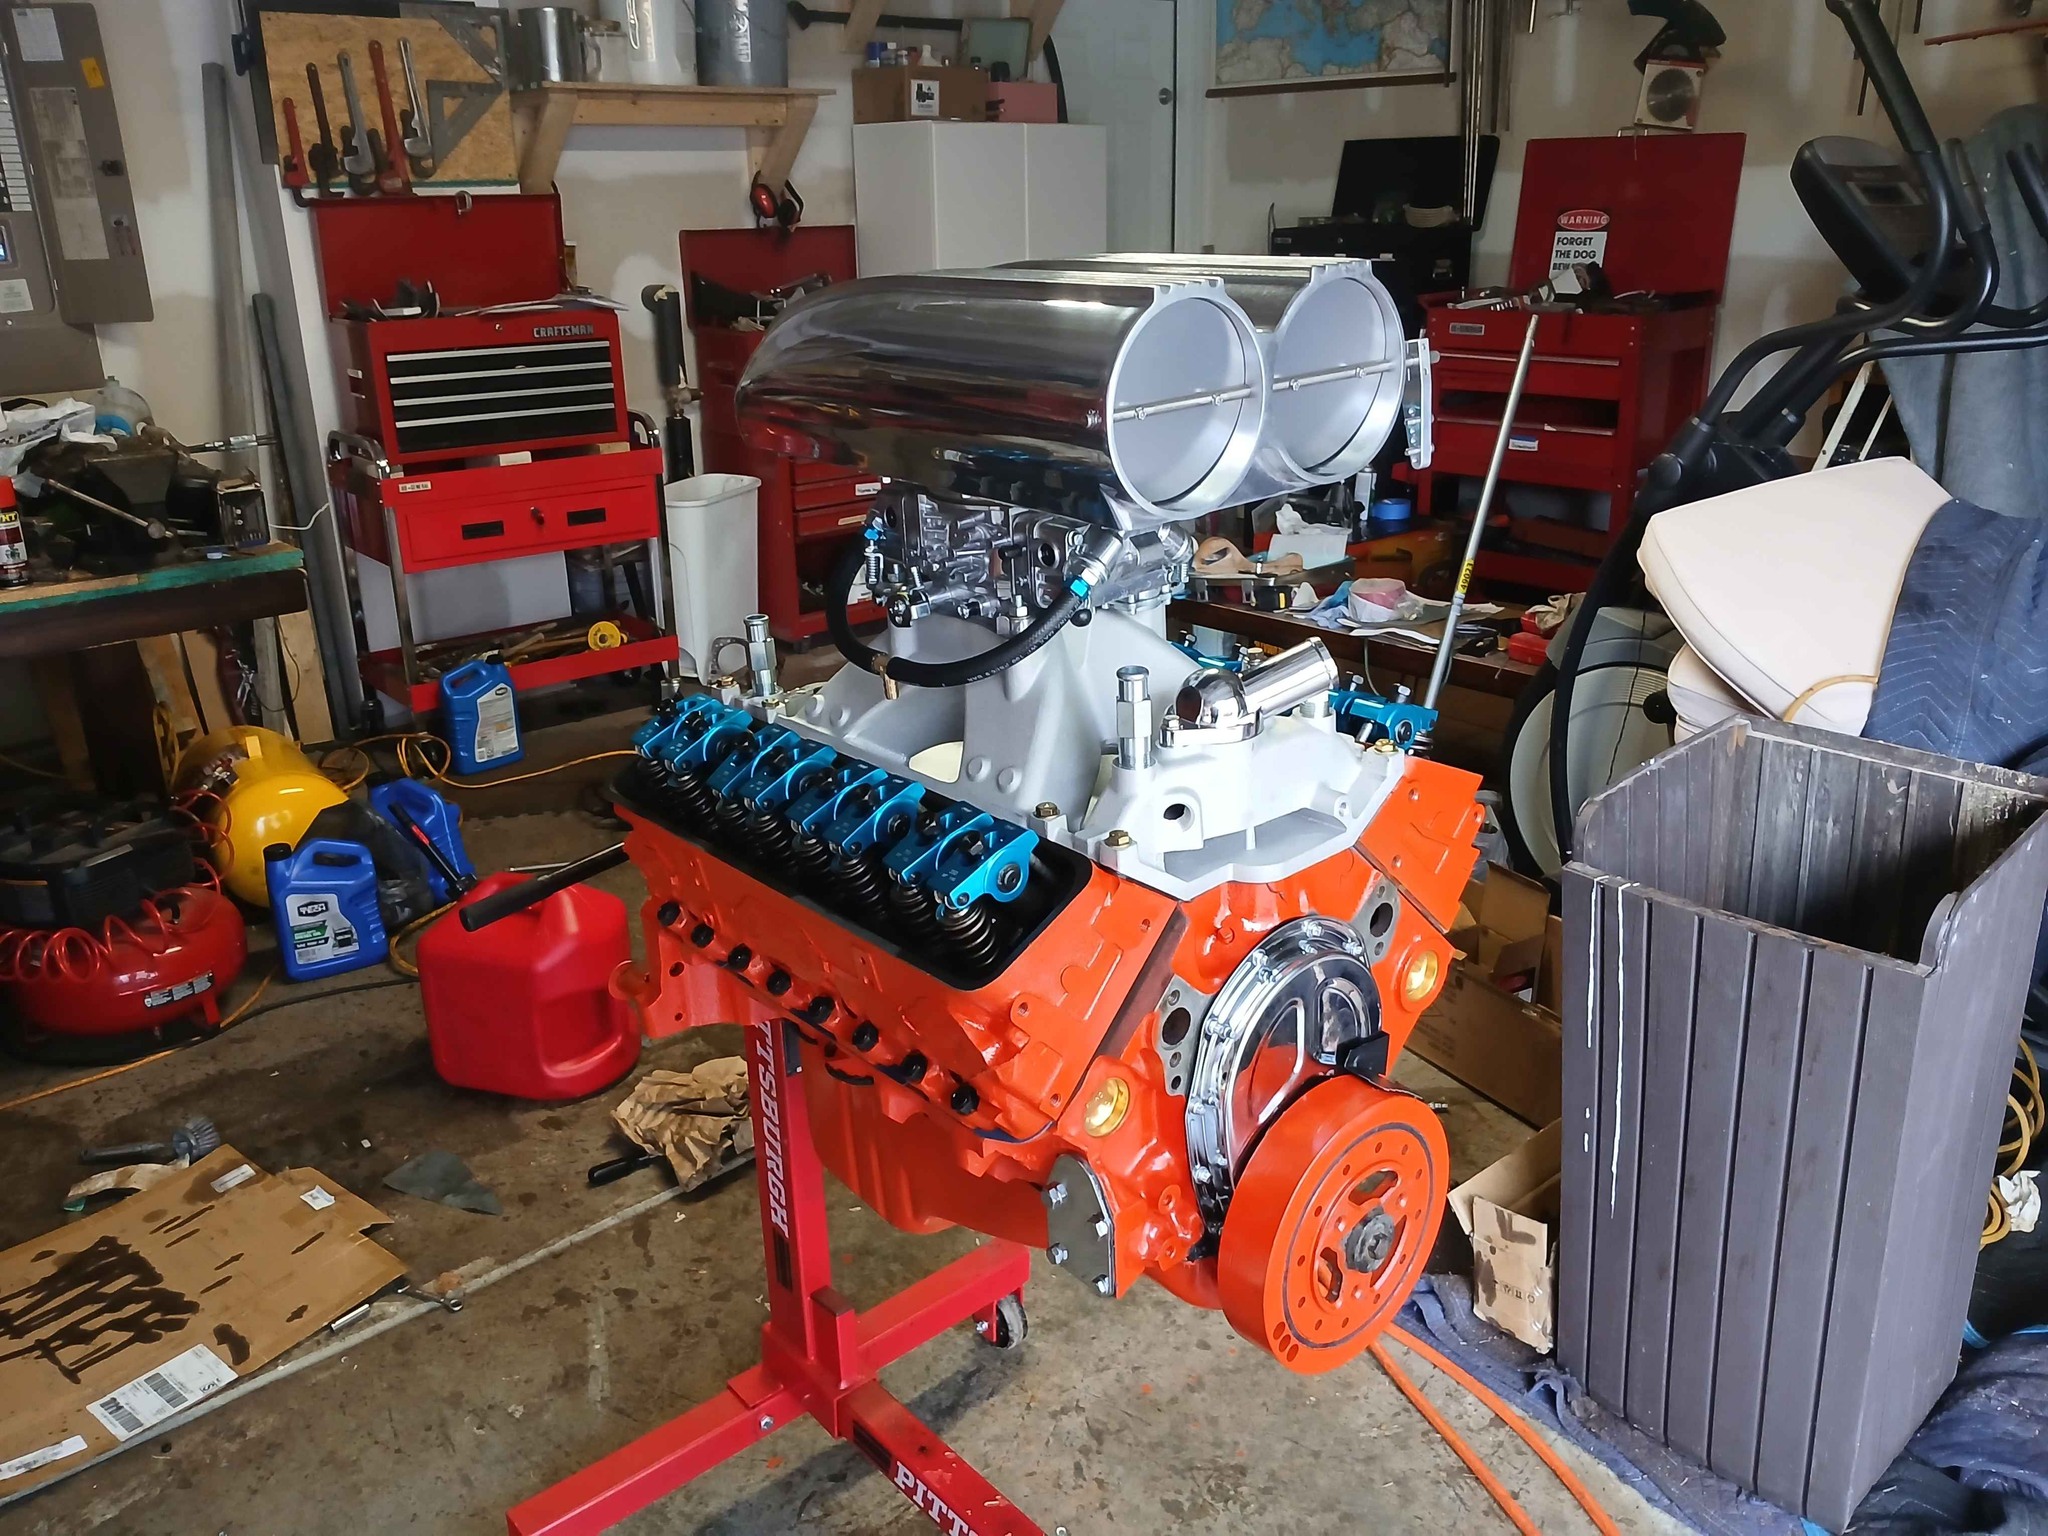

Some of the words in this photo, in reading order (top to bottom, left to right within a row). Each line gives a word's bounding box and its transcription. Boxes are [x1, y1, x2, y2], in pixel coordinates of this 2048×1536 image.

[1560, 215, 1608, 225] WARNING
[1556, 236, 1594, 246] FORGET
[1554, 249, 1572, 259] THE
[1573, 249, 1597, 260] DOG
[533, 325, 593, 338] CRAFTSMAN
[894, 1461, 979, 1536] PITT
